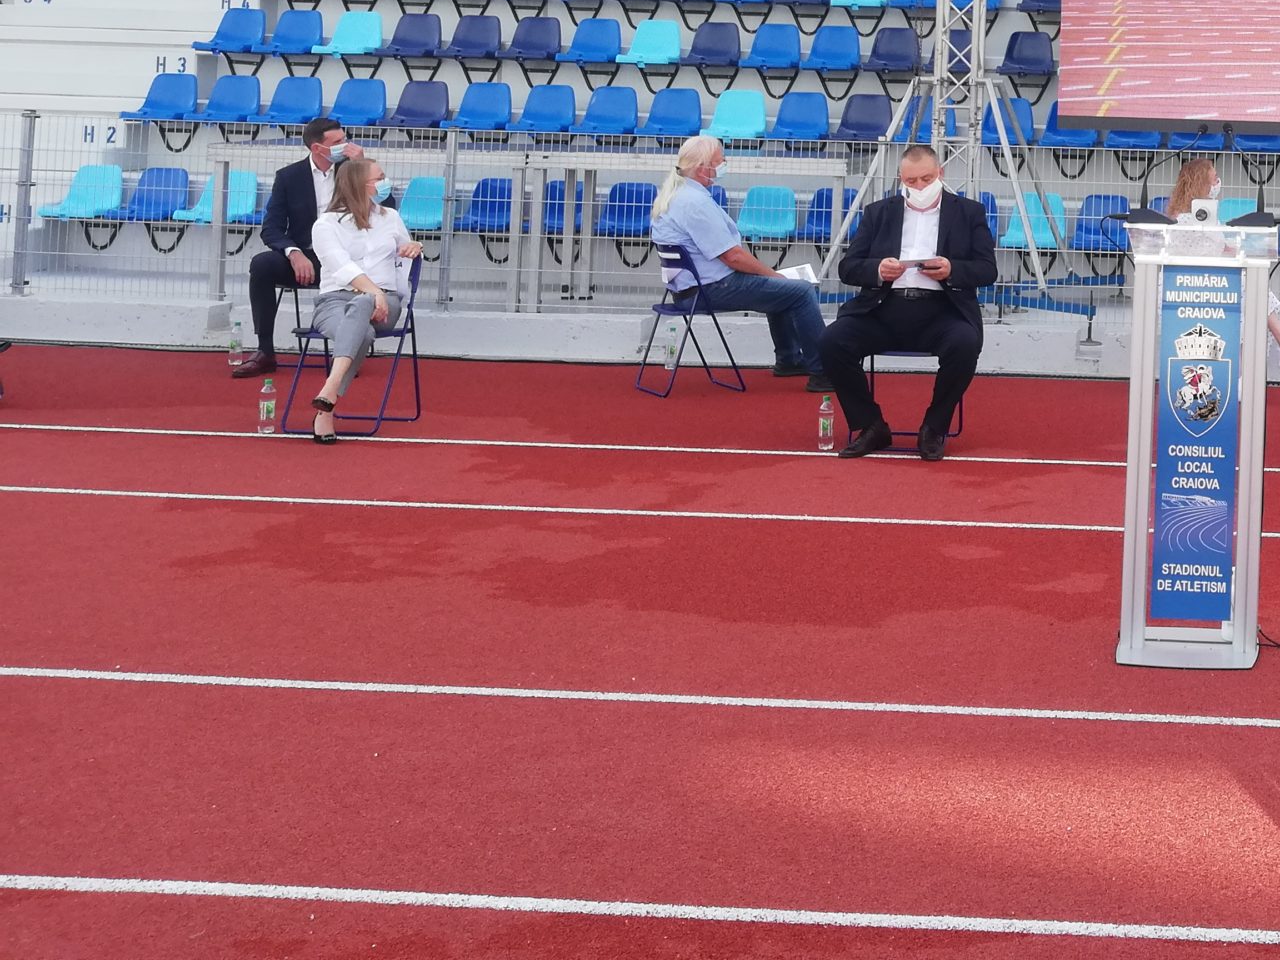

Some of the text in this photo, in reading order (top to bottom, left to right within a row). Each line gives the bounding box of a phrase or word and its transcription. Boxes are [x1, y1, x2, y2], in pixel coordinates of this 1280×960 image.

[156, 56, 187, 73] H 3
[83, 125, 117, 144] H 2
[0, 204, 12, 223] H
[1176, 273, 1229, 288] PRIMĂRIA
[1166, 290, 1238, 304] MUNICIPIULUI
[1177, 306, 1226, 319] CRAIOVA
[1168, 444, 1226, 458] CONSILIUL
[1177, 461, 1215, 474] LOCAL
[1171, 476, 1221, 490] CRAIOVA
[1161, 563, 1223, 577] STADIONUL
[1157, 579, 1227, 593] DE ATLETISM
